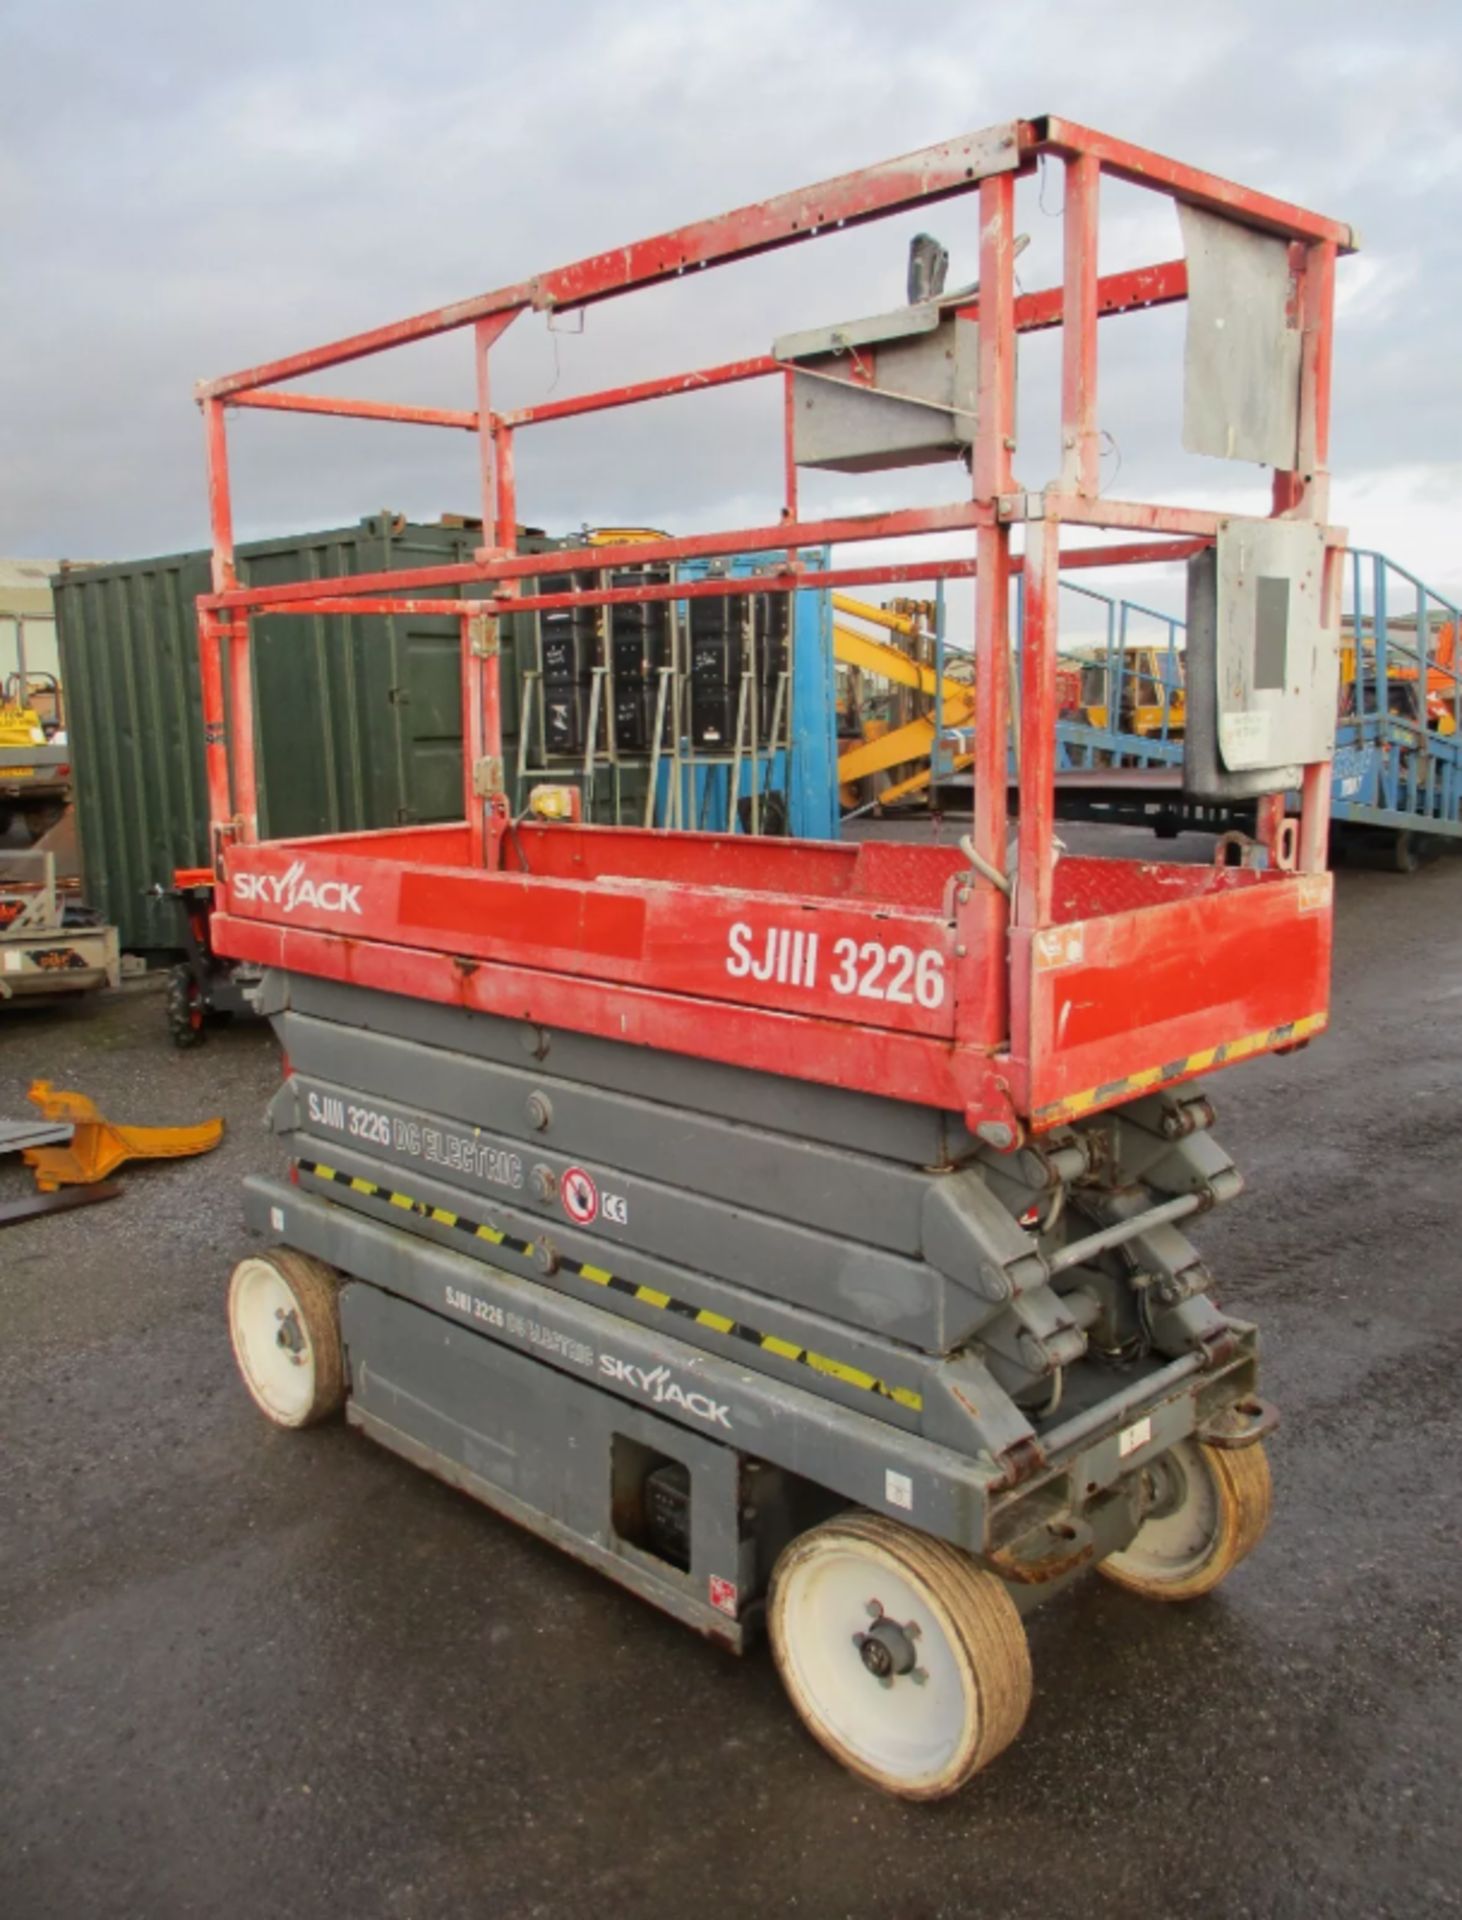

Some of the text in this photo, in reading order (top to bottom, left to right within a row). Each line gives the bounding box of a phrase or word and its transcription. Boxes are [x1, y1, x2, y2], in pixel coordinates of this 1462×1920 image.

[233, 860, 362, 915] SKYJACK
[726, 922, 945, 1008] SJIII 3226
[347, 1105, 391, 1146] 3226
[393, 1117, 421, 1156] DC
[422, 1127, 524, 1189] ELECTRIC
[600, 1354, 733, 1429] SKYJACK
